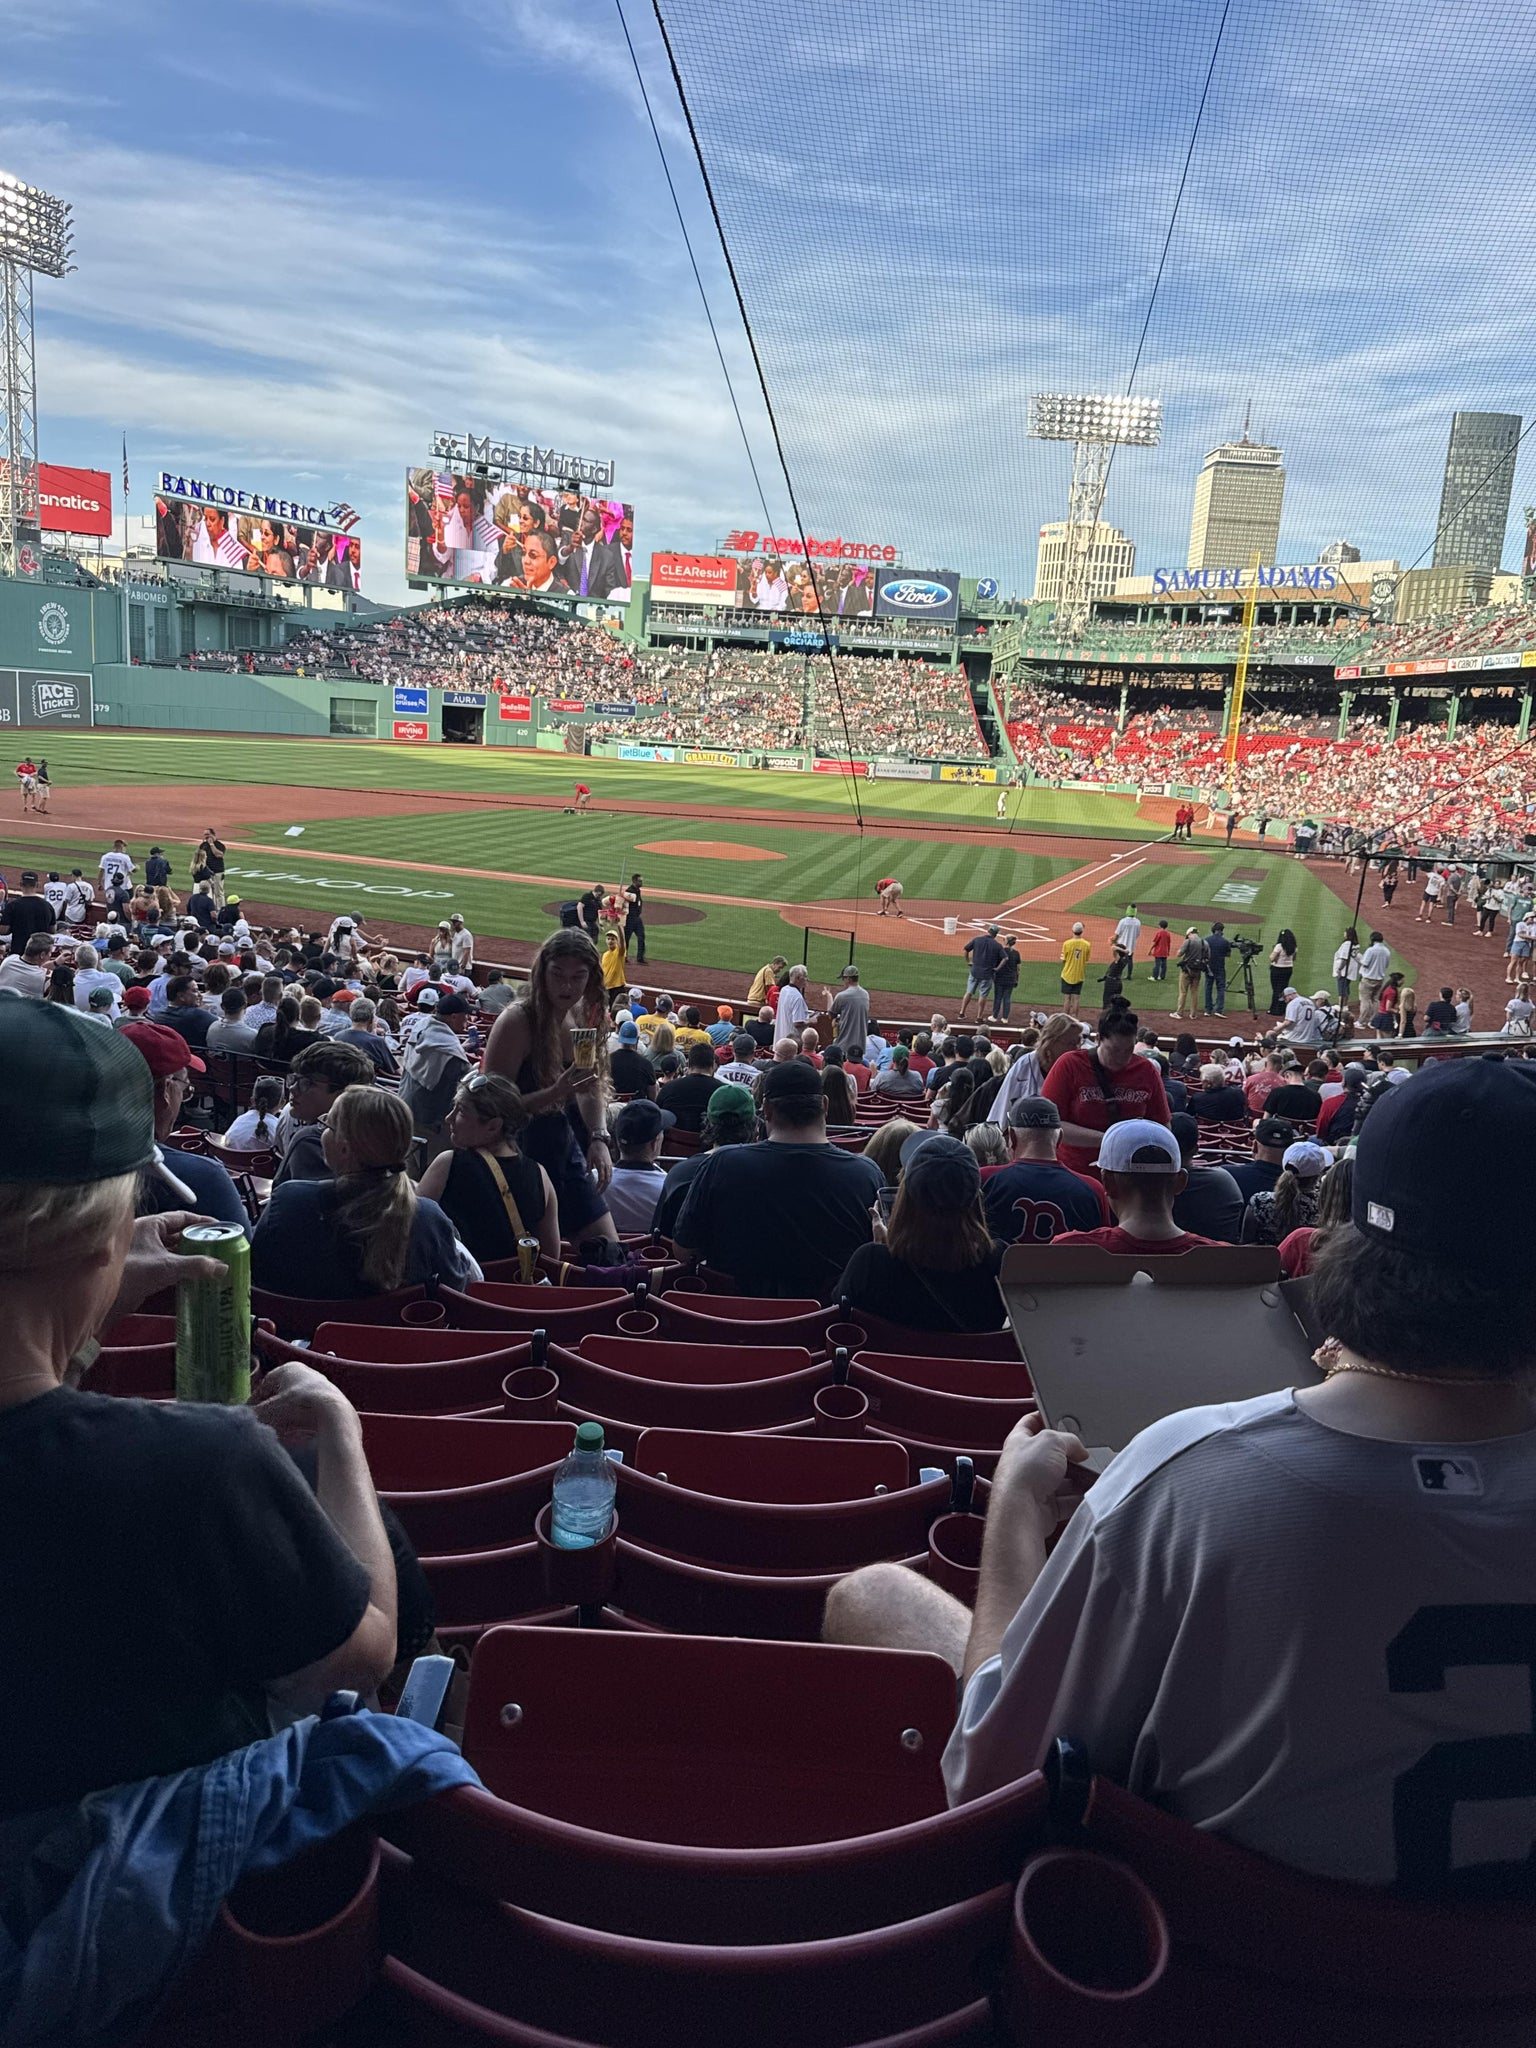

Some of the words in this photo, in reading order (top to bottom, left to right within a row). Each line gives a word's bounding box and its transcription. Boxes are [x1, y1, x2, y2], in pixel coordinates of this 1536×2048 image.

[465, 432, 615, 487] MassMutual
[38, 493, 101, 512] anatics
[162, 472, 216, 502] BANK
[223, 486, 246, 508] OF
[251, 493, 328, 527] AMERICA
[660, 564, 727, 579] CLEAResult
[1152, 567, 1244, 594] SAMUEL
[1257, 565, 1337, 591] ADAMS
[130, 590, 168, 604] ABIOMED
[893, 585, 938, 604] Ford
[784, 637, 824, 647] ORCHARD
[1294, 655, 1314, 664] 6:50
[41, 684, 74, 699] ACE
[395, 693, 407, 701] city
[42, 698, 75, 711] TICKET
[395, 699, 418, 707] cruises
[398, 726, 423, 735] IRVING
[517, 728, 528, 736] 420
[621, 748, 651, 758] jetBlue
[685, 752, 718, 762] GRANITE
[767, 758, 798, 767] wasabi
[107, 863, 120, 875] 27
[224, 867, 455, 898] WHOOP
[49, 889, 63, 901] 22
[1075, 949, 1082, 960] 7
[1225, 1067, 1244, 1083] 24
